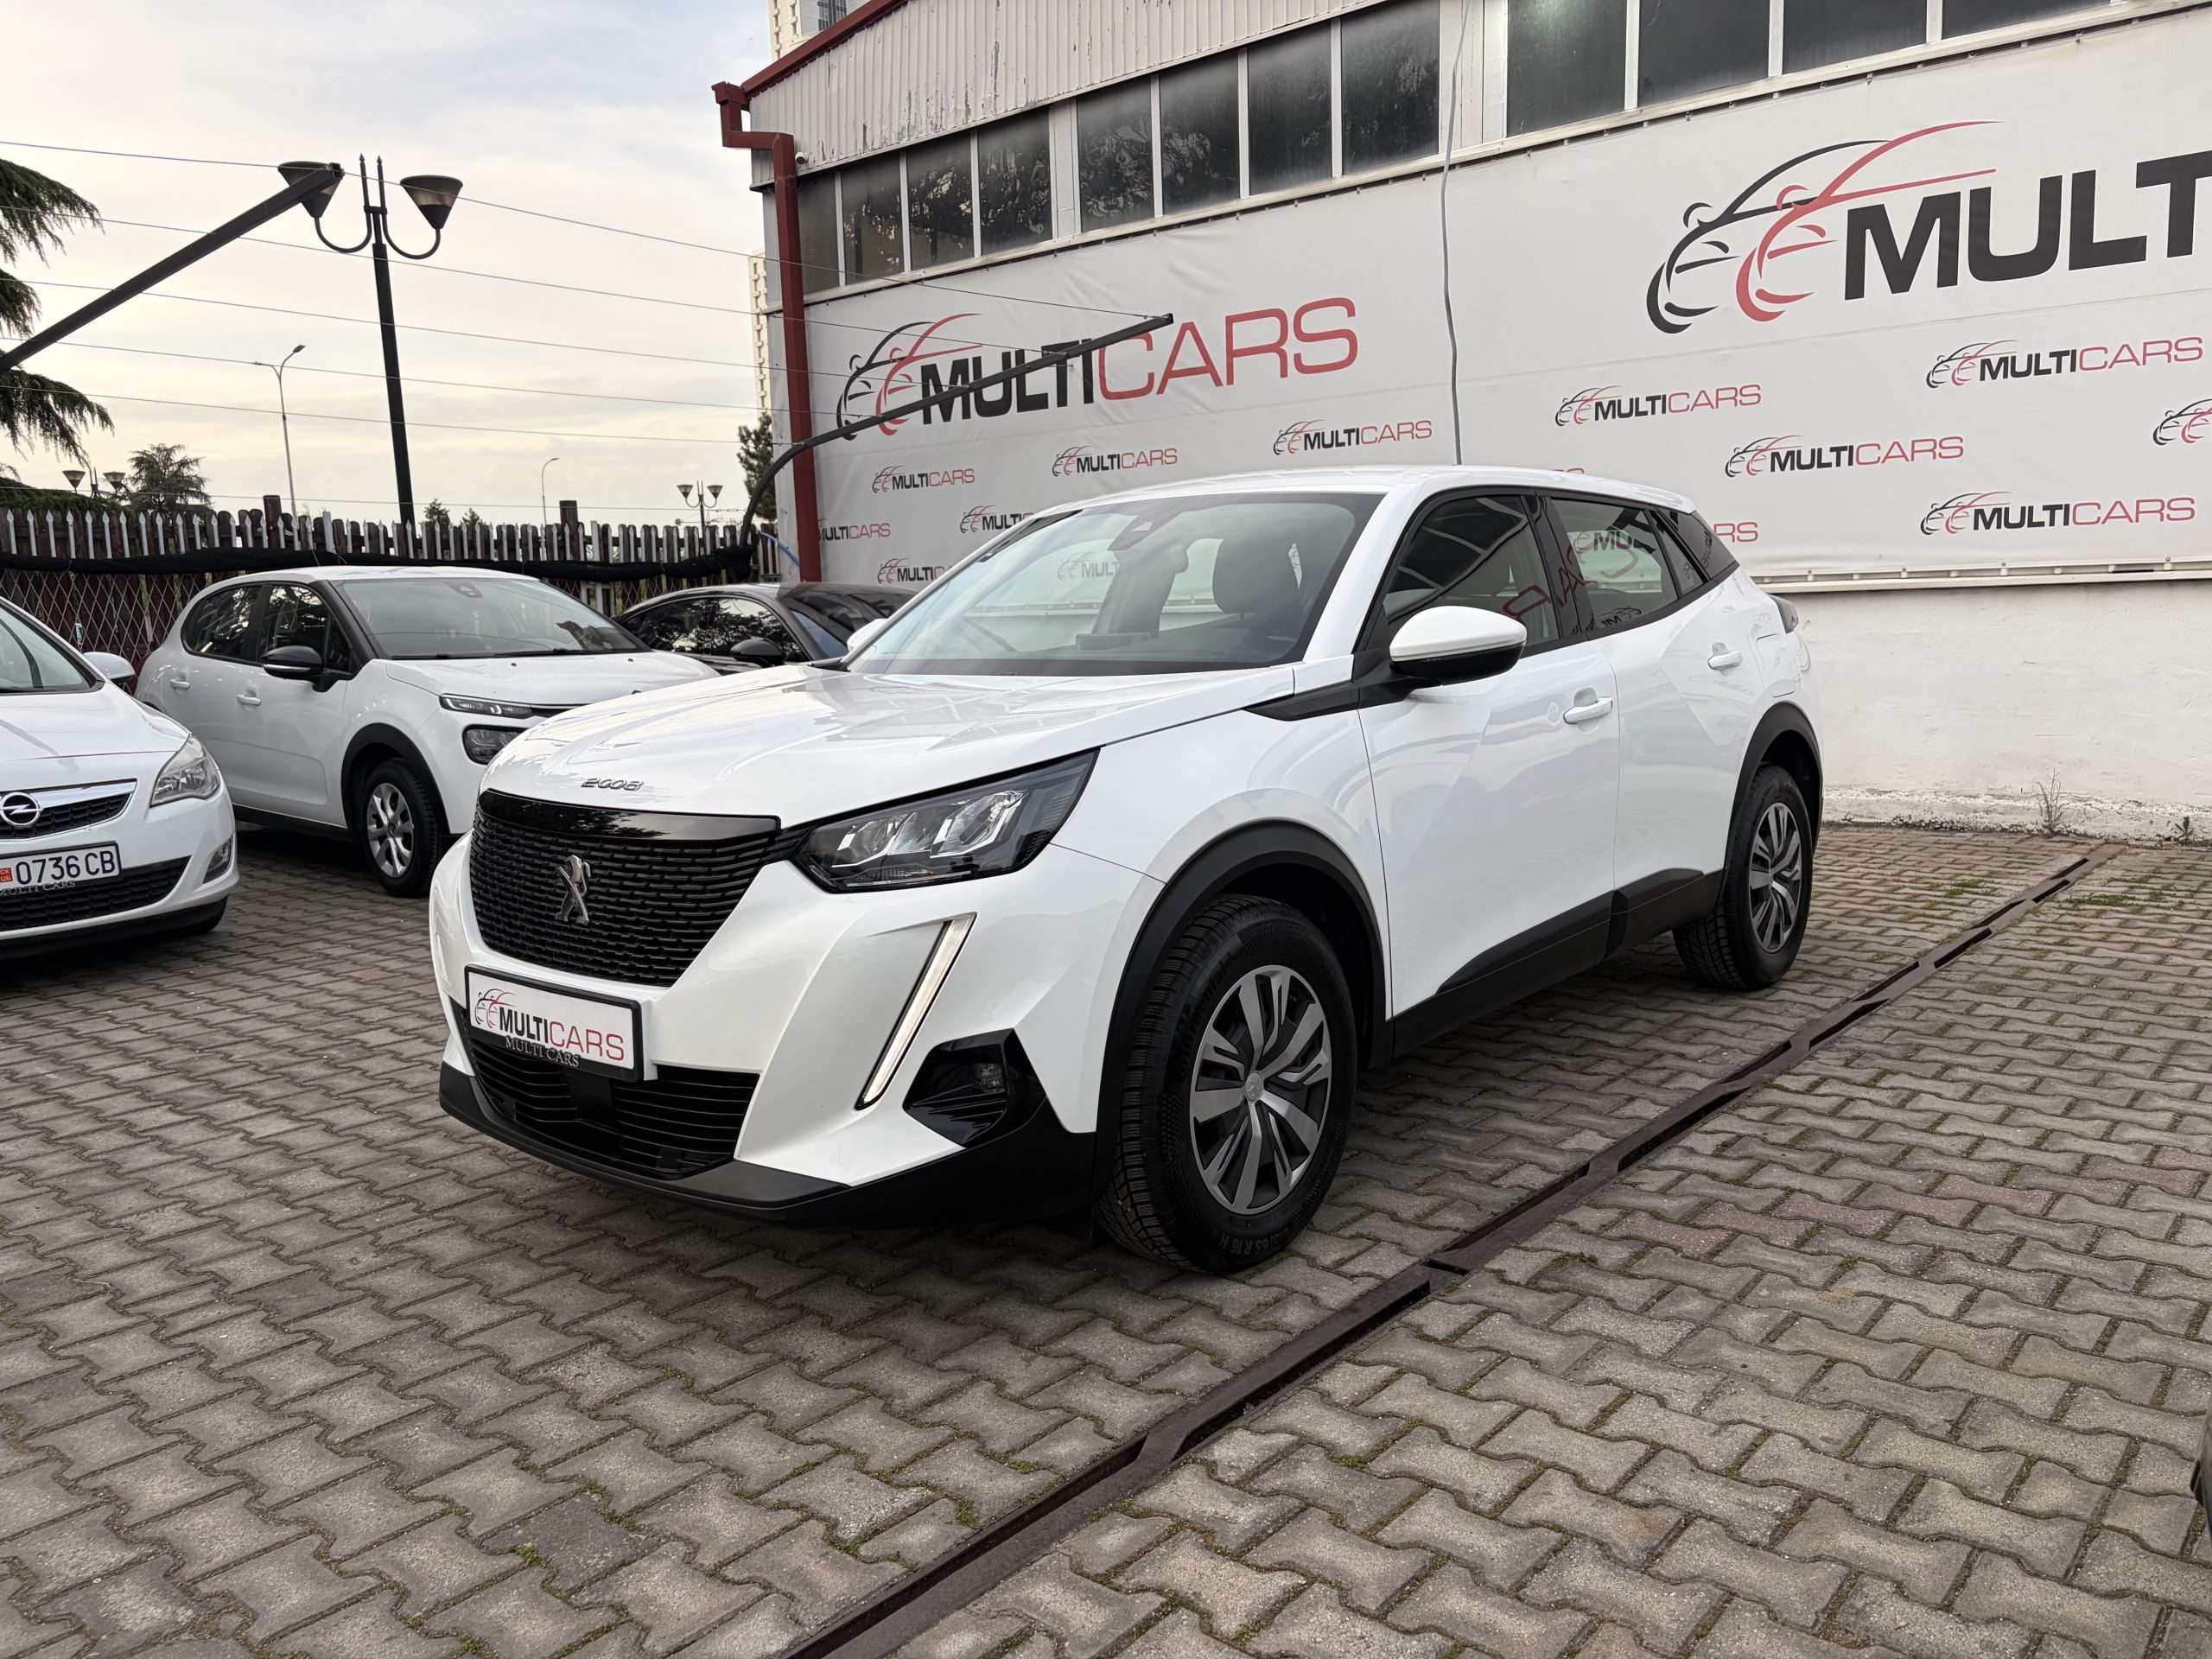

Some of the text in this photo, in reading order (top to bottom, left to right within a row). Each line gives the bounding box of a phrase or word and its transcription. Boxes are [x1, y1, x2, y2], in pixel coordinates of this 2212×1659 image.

[920, 296, 1359, 425] MULTICARS
[1979, 337, 2203, 382] MULTICARS
[1593, 385, 1762, 422] MULTICARS
[1303, 420, 1432, 451] MULTICARS
[1076, 448, 1178, 474] MULTICARS
[1770, 436, 1964, 473] MULTICARS
[892, 468, 976, 490] MULTICARS
[1973, 497, 2196, 531] MULTICARS
[581, 778, 645, 791] 2008
[16, 850, 115, 885] 0736 CB
[43, 880, 76, 891] CARS
[499, 1007, 624, 1060] MULTICARS
[505, 1036, 580, 1068] MULTI CARS
